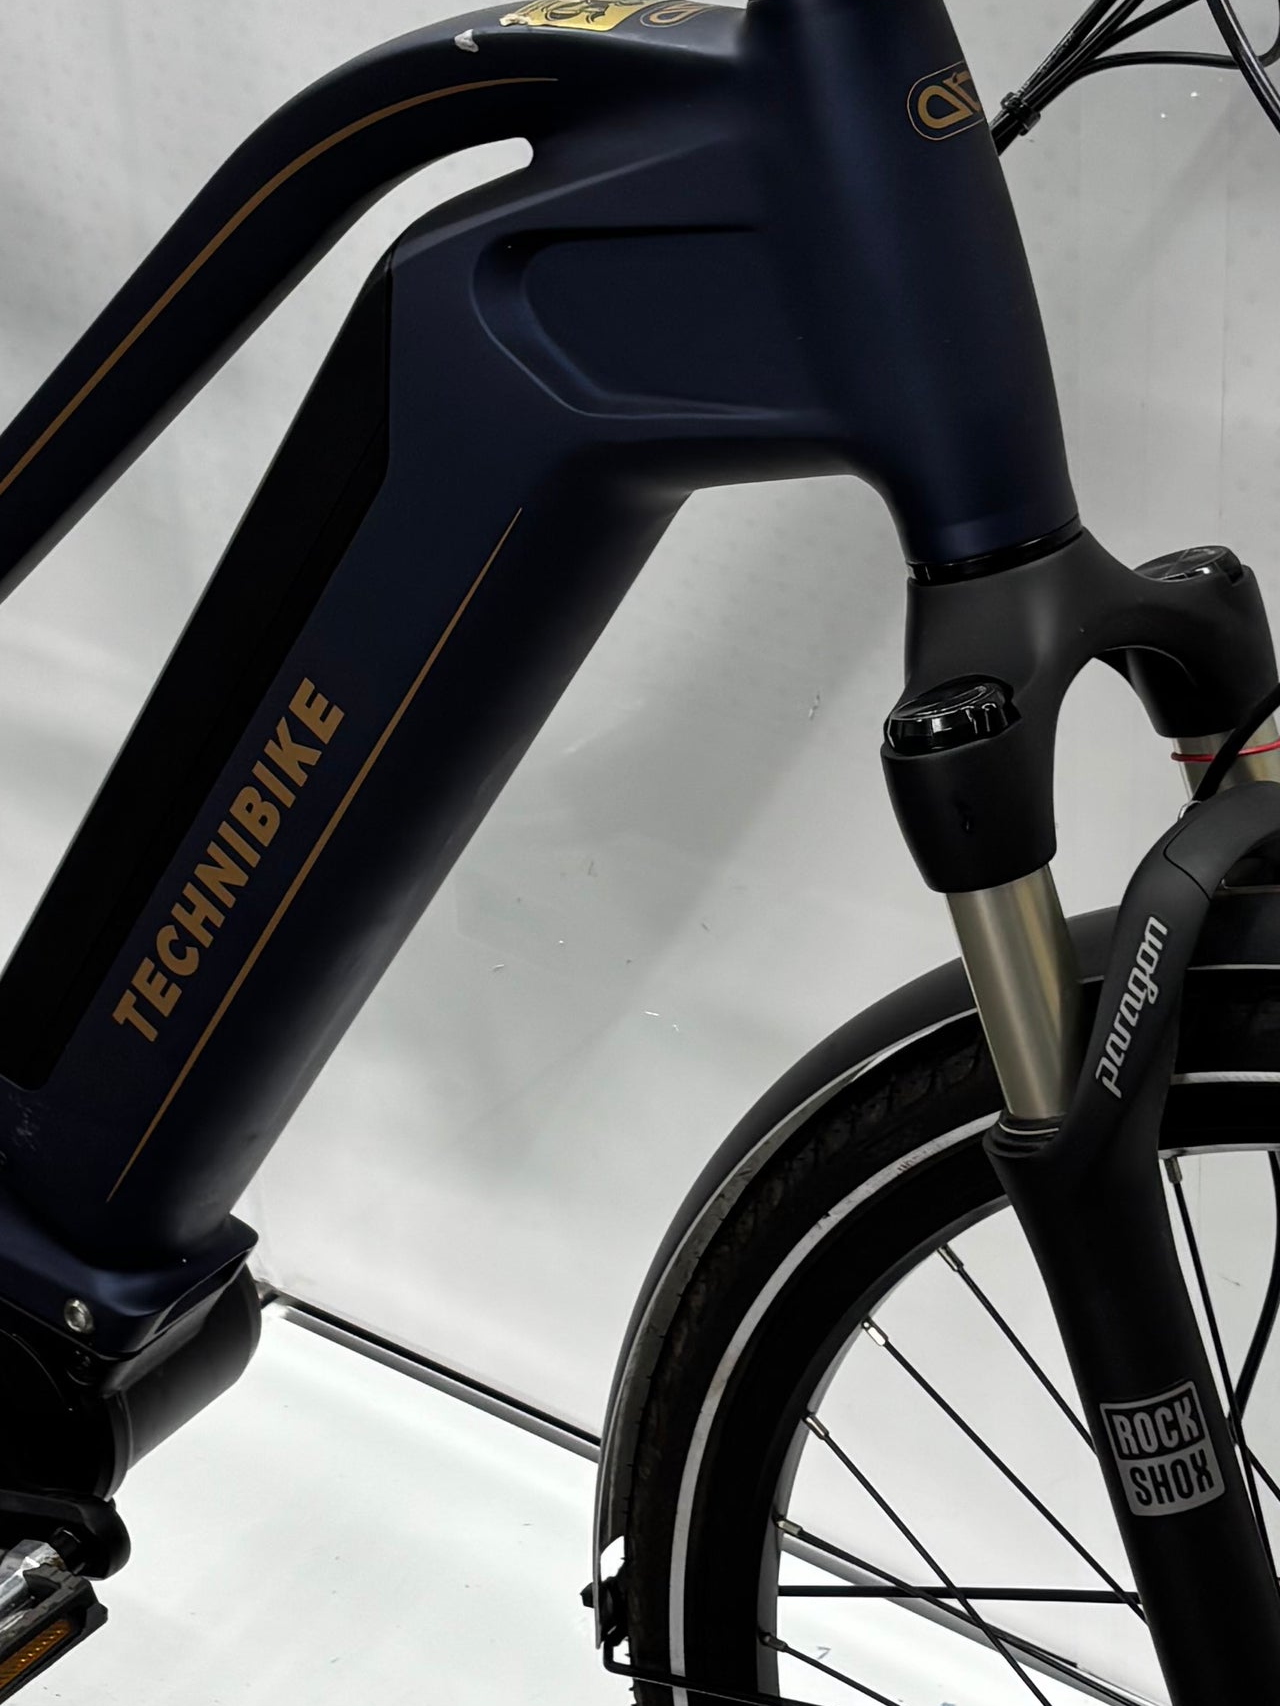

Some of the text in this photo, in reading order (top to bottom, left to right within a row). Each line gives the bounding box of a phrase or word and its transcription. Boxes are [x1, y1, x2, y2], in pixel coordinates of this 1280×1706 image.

[112, 677, 345, 1043] TECHNIBIKE
[1095, 916, 1168, 1099] paragon
[1111, 1396, 1199, 1456] ROCK
[1130, 1449, 1214, 1506] SHOX
